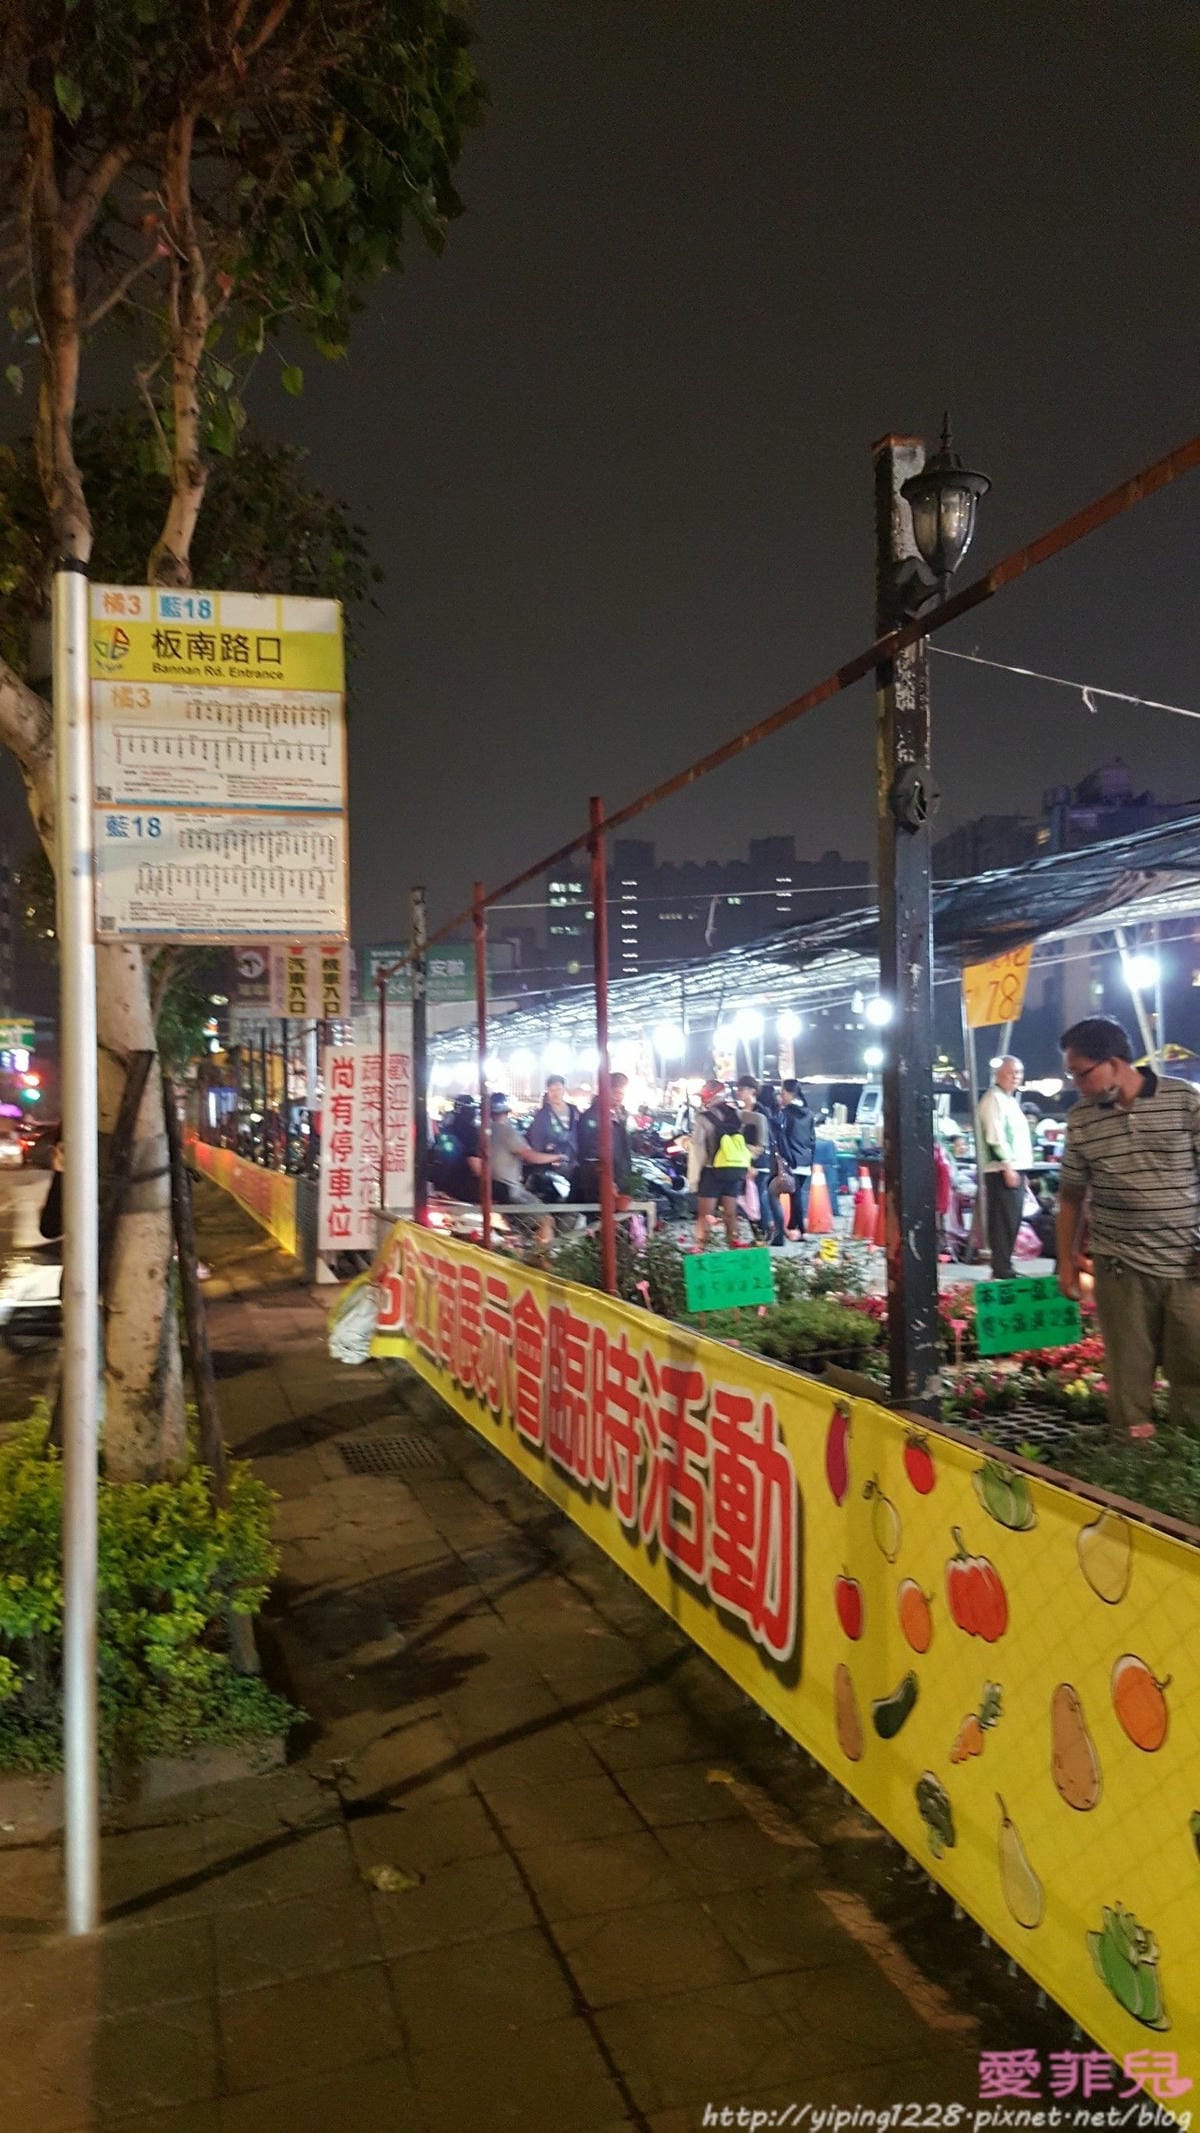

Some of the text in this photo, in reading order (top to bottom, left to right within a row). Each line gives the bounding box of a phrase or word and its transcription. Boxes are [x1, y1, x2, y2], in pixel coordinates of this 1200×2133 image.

[160, 595, 212, 619] 藍18
[152, 629, 282, 665] 板南路口
[152, 663, 285, 680] Bannan Rd. Entrance
[105, 815, 162, 838] 藍18
[328, 1055, 354, 1238] 尚有停車位
